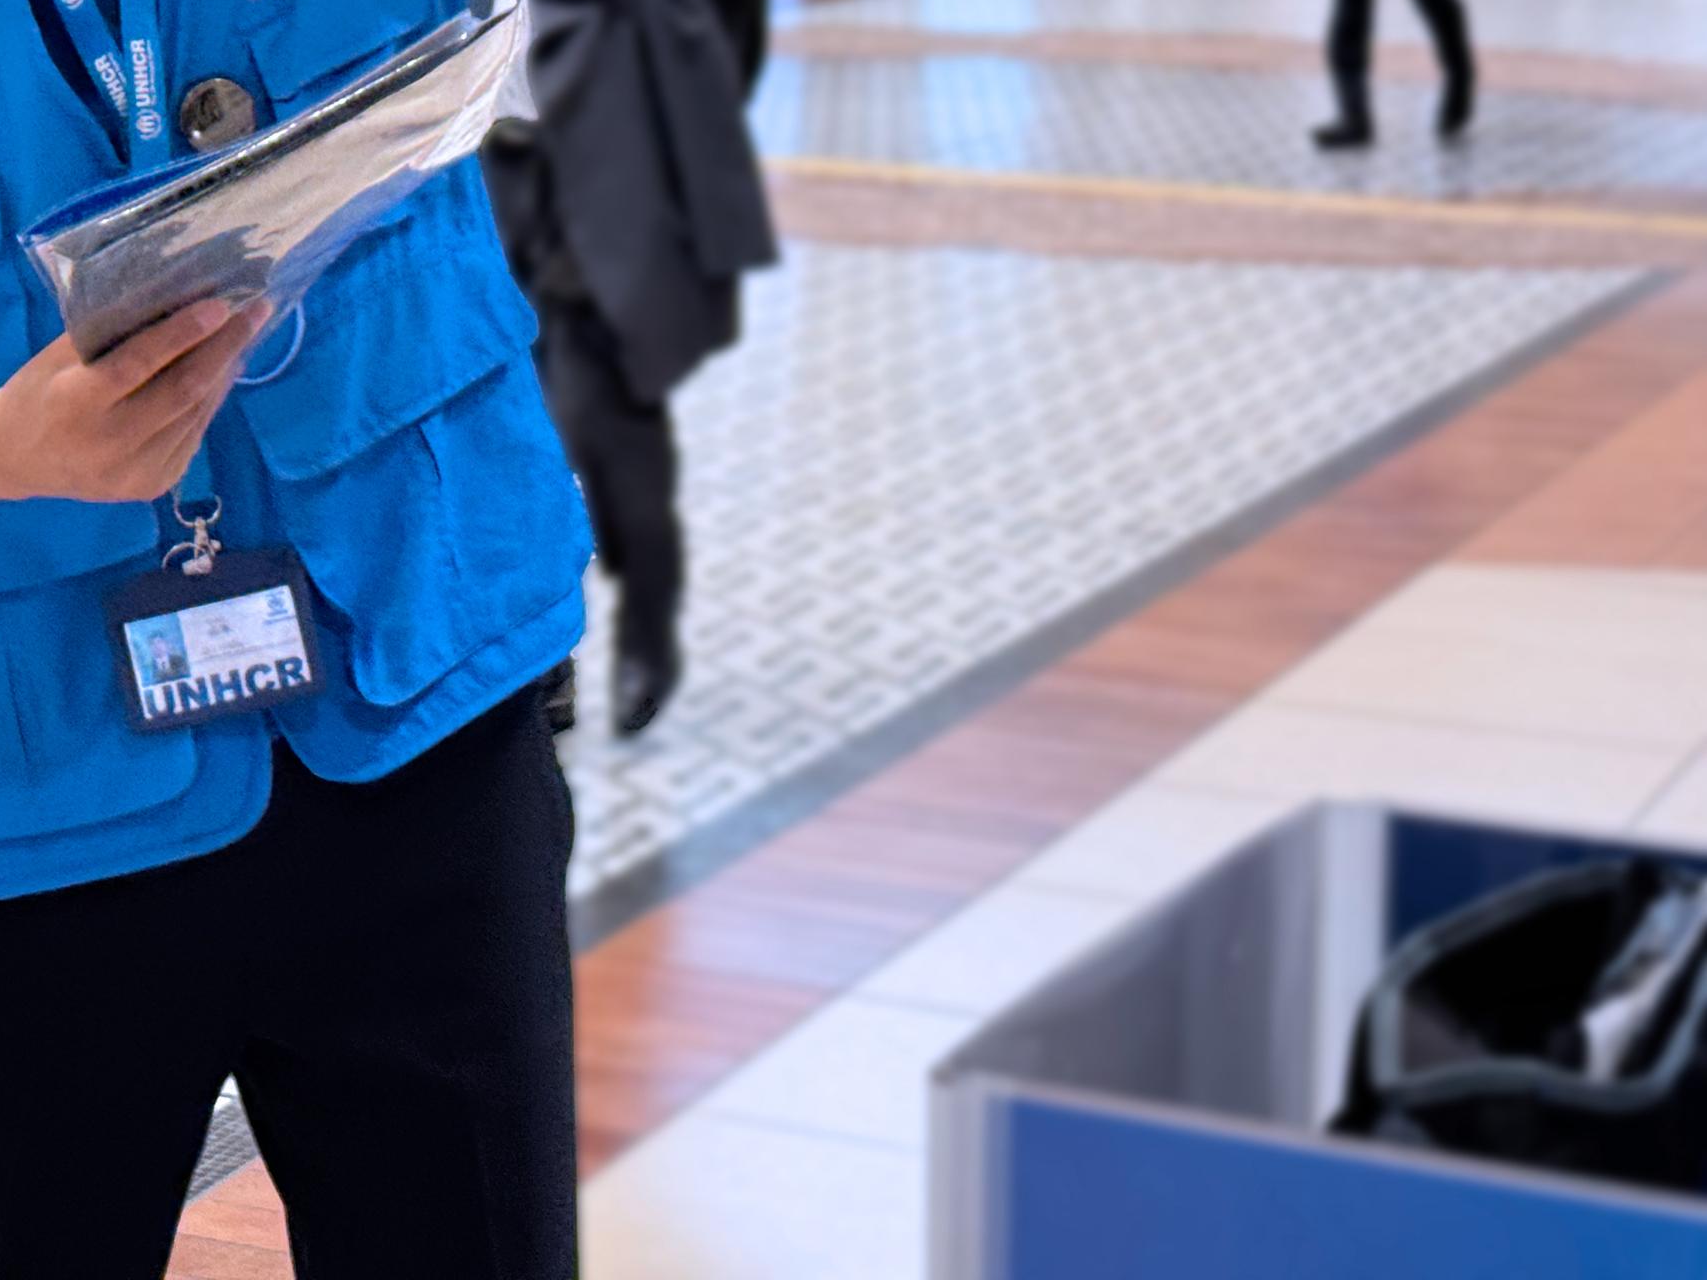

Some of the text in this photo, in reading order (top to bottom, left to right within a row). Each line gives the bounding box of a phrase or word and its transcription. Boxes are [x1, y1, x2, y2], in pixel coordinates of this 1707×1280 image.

[94, 53, 128, 117] NHCR
[130, 38, 151, 108] UNHCR
[144, 656, 305, 716] UNHCR
